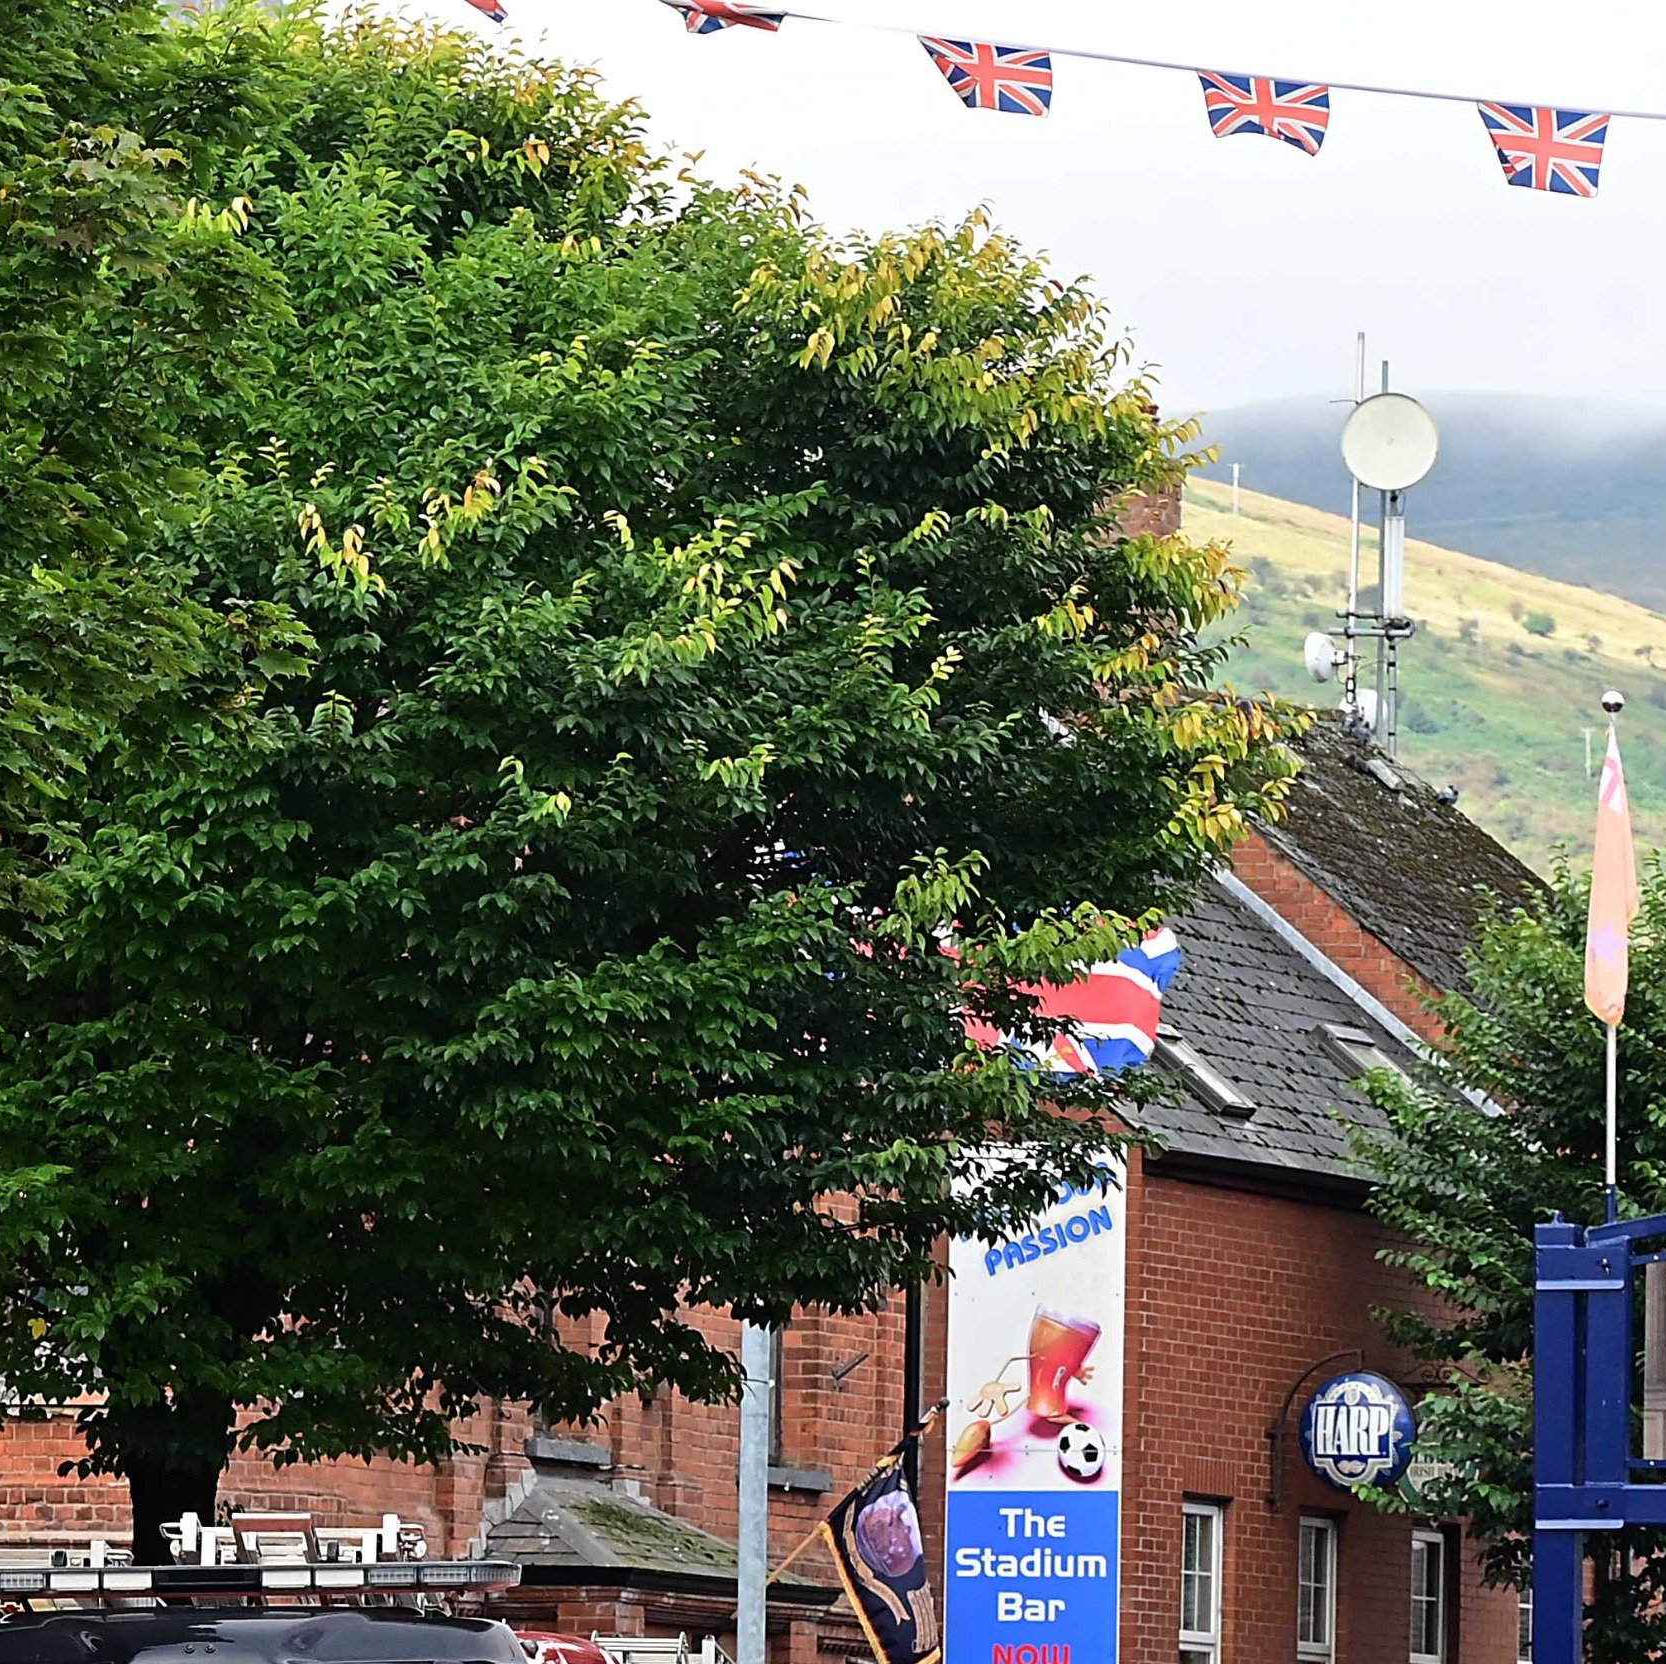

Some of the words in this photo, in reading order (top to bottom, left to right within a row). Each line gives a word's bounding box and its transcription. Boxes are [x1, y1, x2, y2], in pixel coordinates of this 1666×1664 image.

[985, 1205, 1113, 1276] PASSION
[1316, 1405, 1390, 1456] HARP
[999, 1508, 1067, 1538] The
[955, 1548, 1107, 1578] Stadium
[997, 1591, 1066, 1622] Bar
